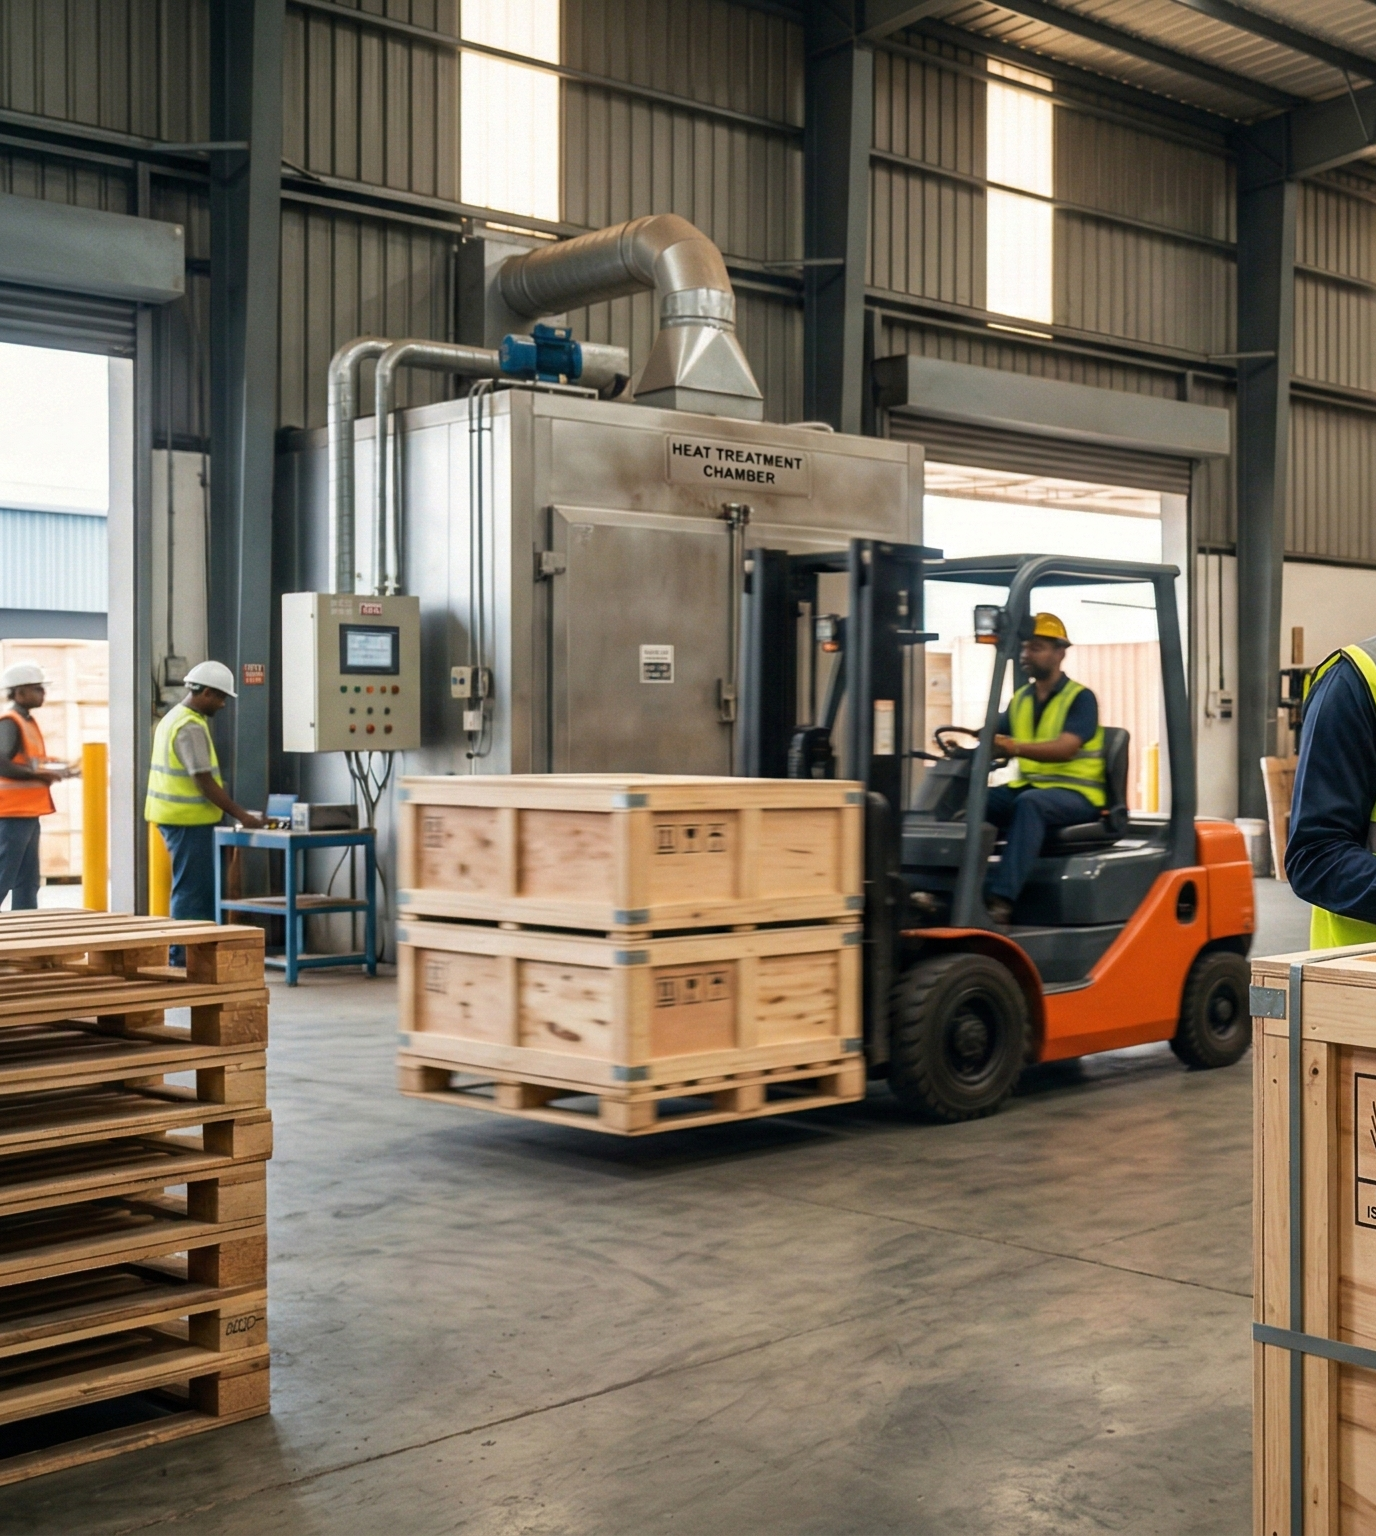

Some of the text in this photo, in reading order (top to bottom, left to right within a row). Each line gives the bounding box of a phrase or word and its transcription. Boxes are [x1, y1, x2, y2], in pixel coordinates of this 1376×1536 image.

[672, 442, 803, 470] HEAT TREATMENT
[703, 464, 776, 484] CHAMBER
